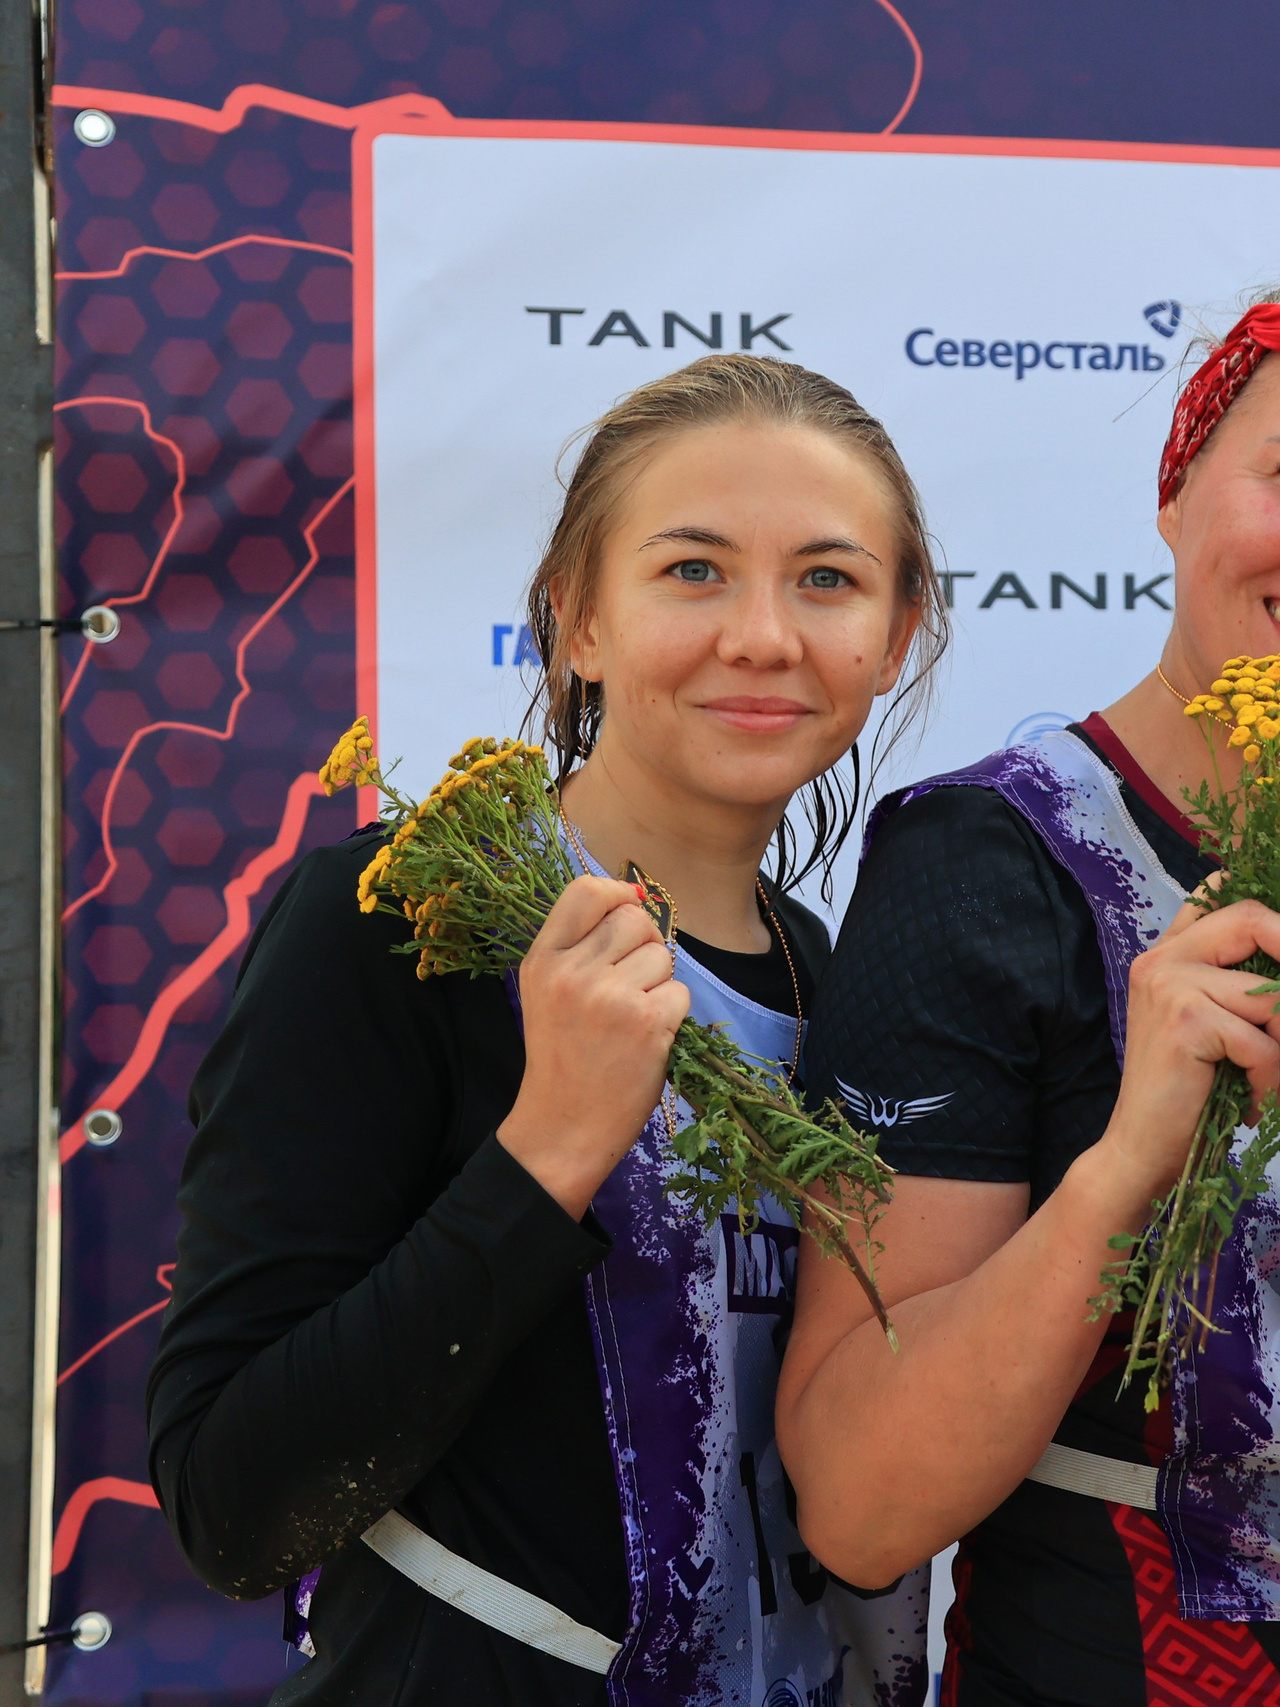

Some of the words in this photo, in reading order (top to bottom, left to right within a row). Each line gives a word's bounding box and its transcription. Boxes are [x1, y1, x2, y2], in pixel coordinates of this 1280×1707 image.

[525, 306, 793, 351] TANK
[905, 327, 1165, 381] Северсталь
[937, 570, 1173, 611] TANK
